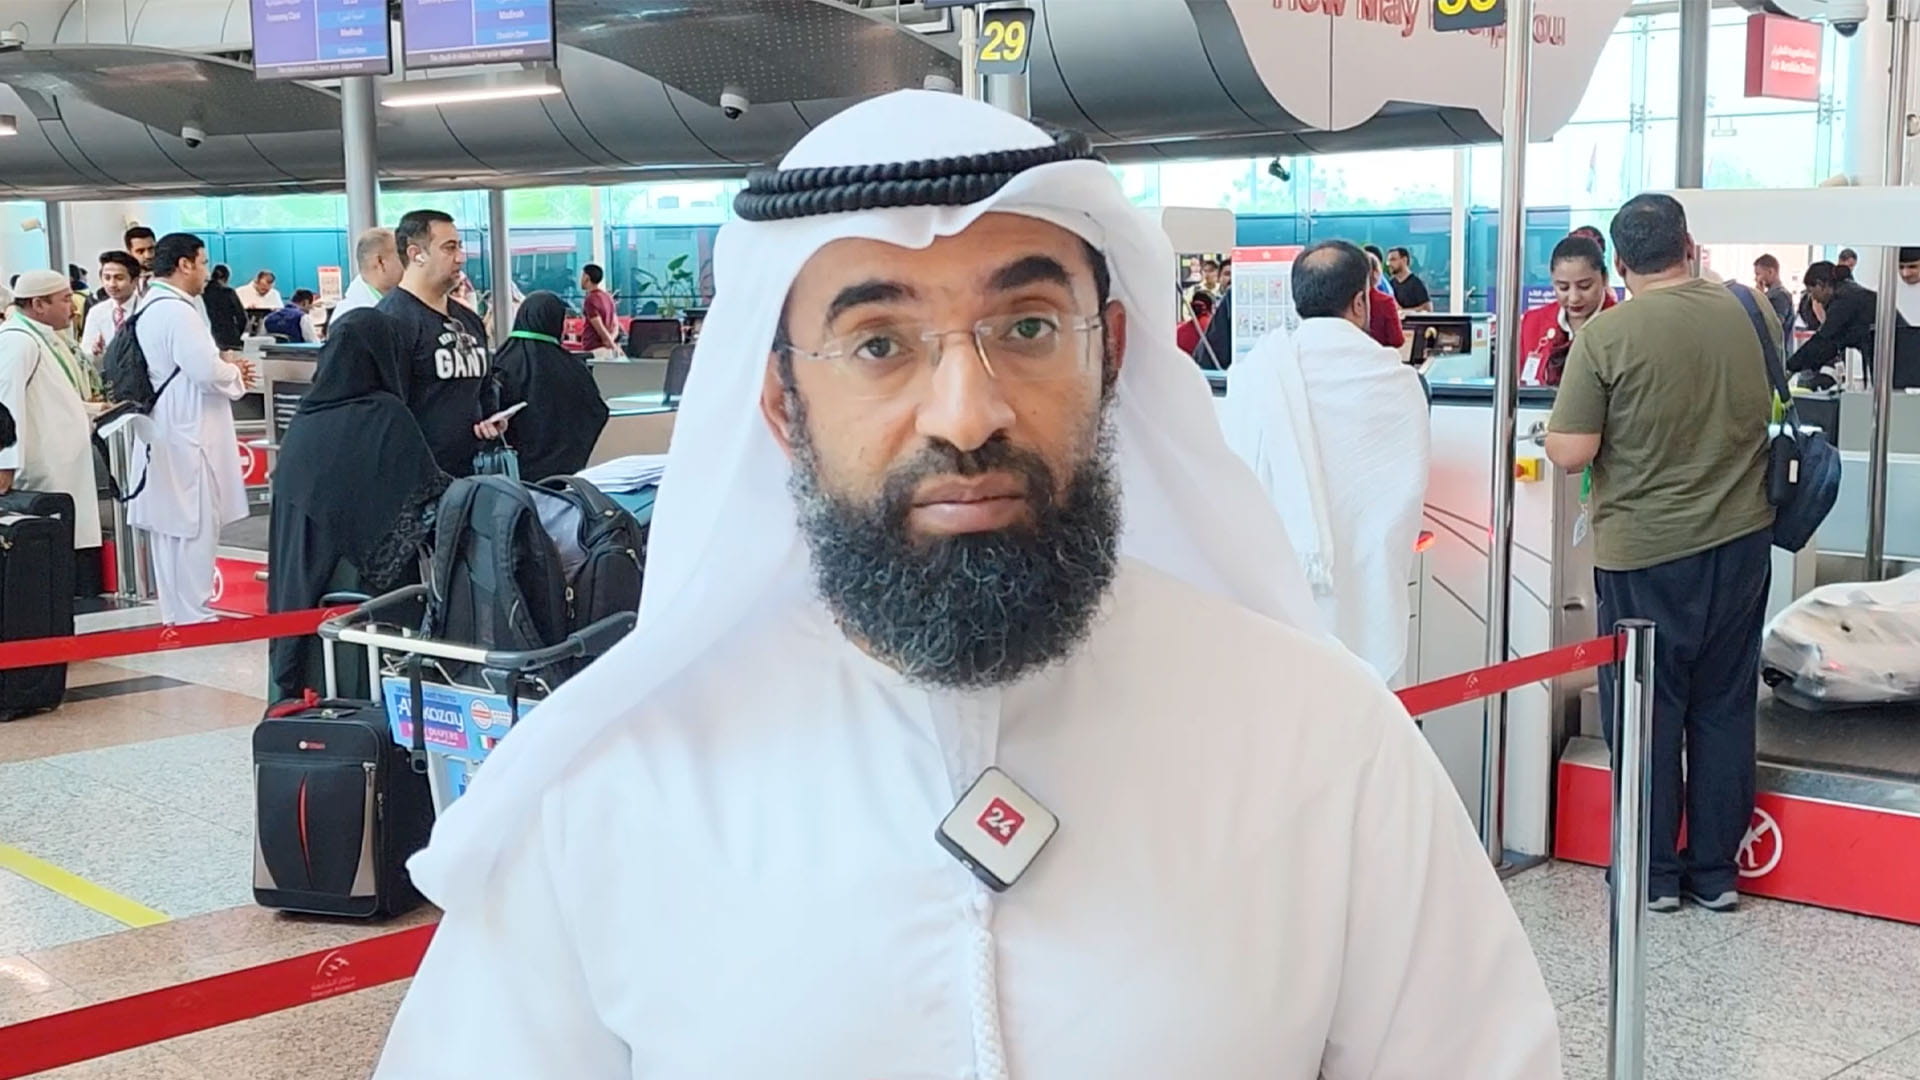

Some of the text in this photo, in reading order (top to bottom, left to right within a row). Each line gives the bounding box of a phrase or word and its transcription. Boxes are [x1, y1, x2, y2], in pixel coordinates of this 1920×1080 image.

[1357, 0, 1420, 37] May
[980, 20, 1026, 61] 29
[984, 806, 1017, 838] 24
